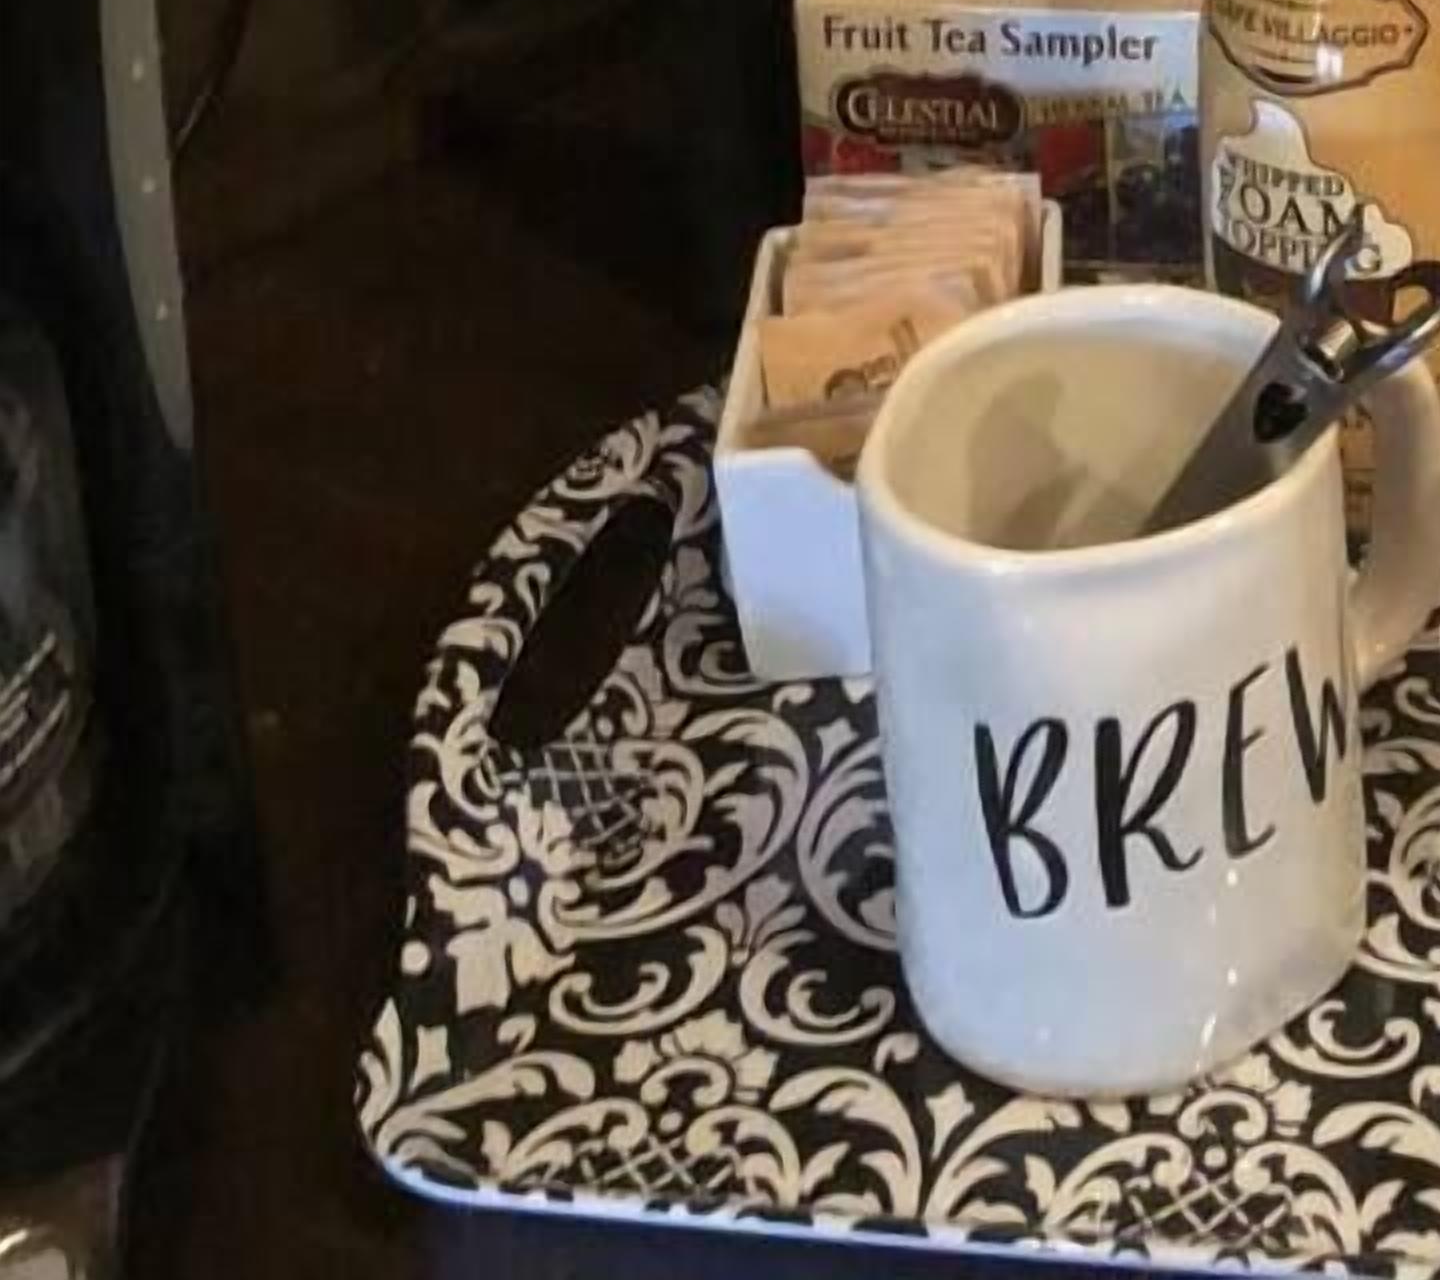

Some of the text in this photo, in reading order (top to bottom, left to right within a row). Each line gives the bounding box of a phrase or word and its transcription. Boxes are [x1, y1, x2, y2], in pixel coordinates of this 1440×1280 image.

[822, 16, 1161, 68] Fruit Tea Sampler
[1262, 13, 1400, 49] VILLAGGIO
[1222, 218, 1383, 274] OPPIG
[973, 645, 1348, 921] BREW
